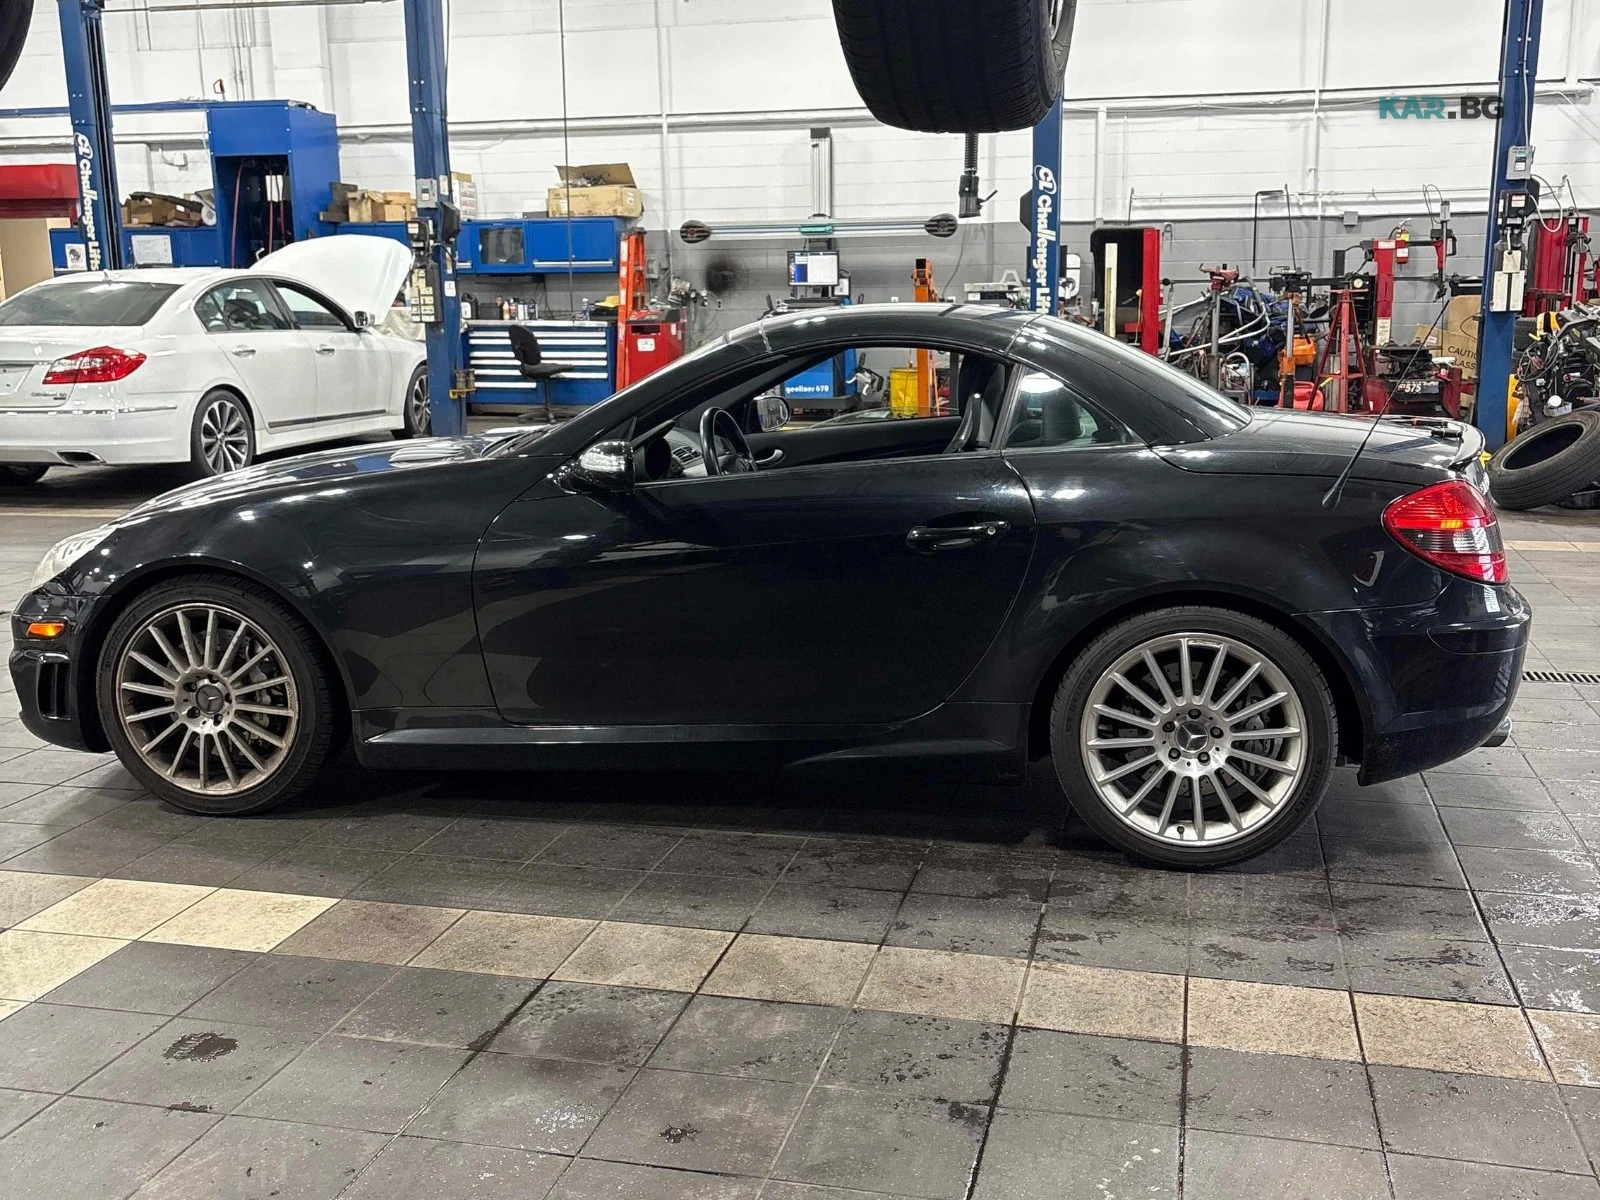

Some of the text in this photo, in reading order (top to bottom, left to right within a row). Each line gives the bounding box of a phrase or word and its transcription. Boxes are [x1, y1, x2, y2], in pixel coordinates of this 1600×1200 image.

[80, 159, 97, 240] Challenger
[1033, 195, 1056, 286] Challenger
[1036, 288, 1051, 314] Lift
[785, 385, 829, 394] geoliner 670
